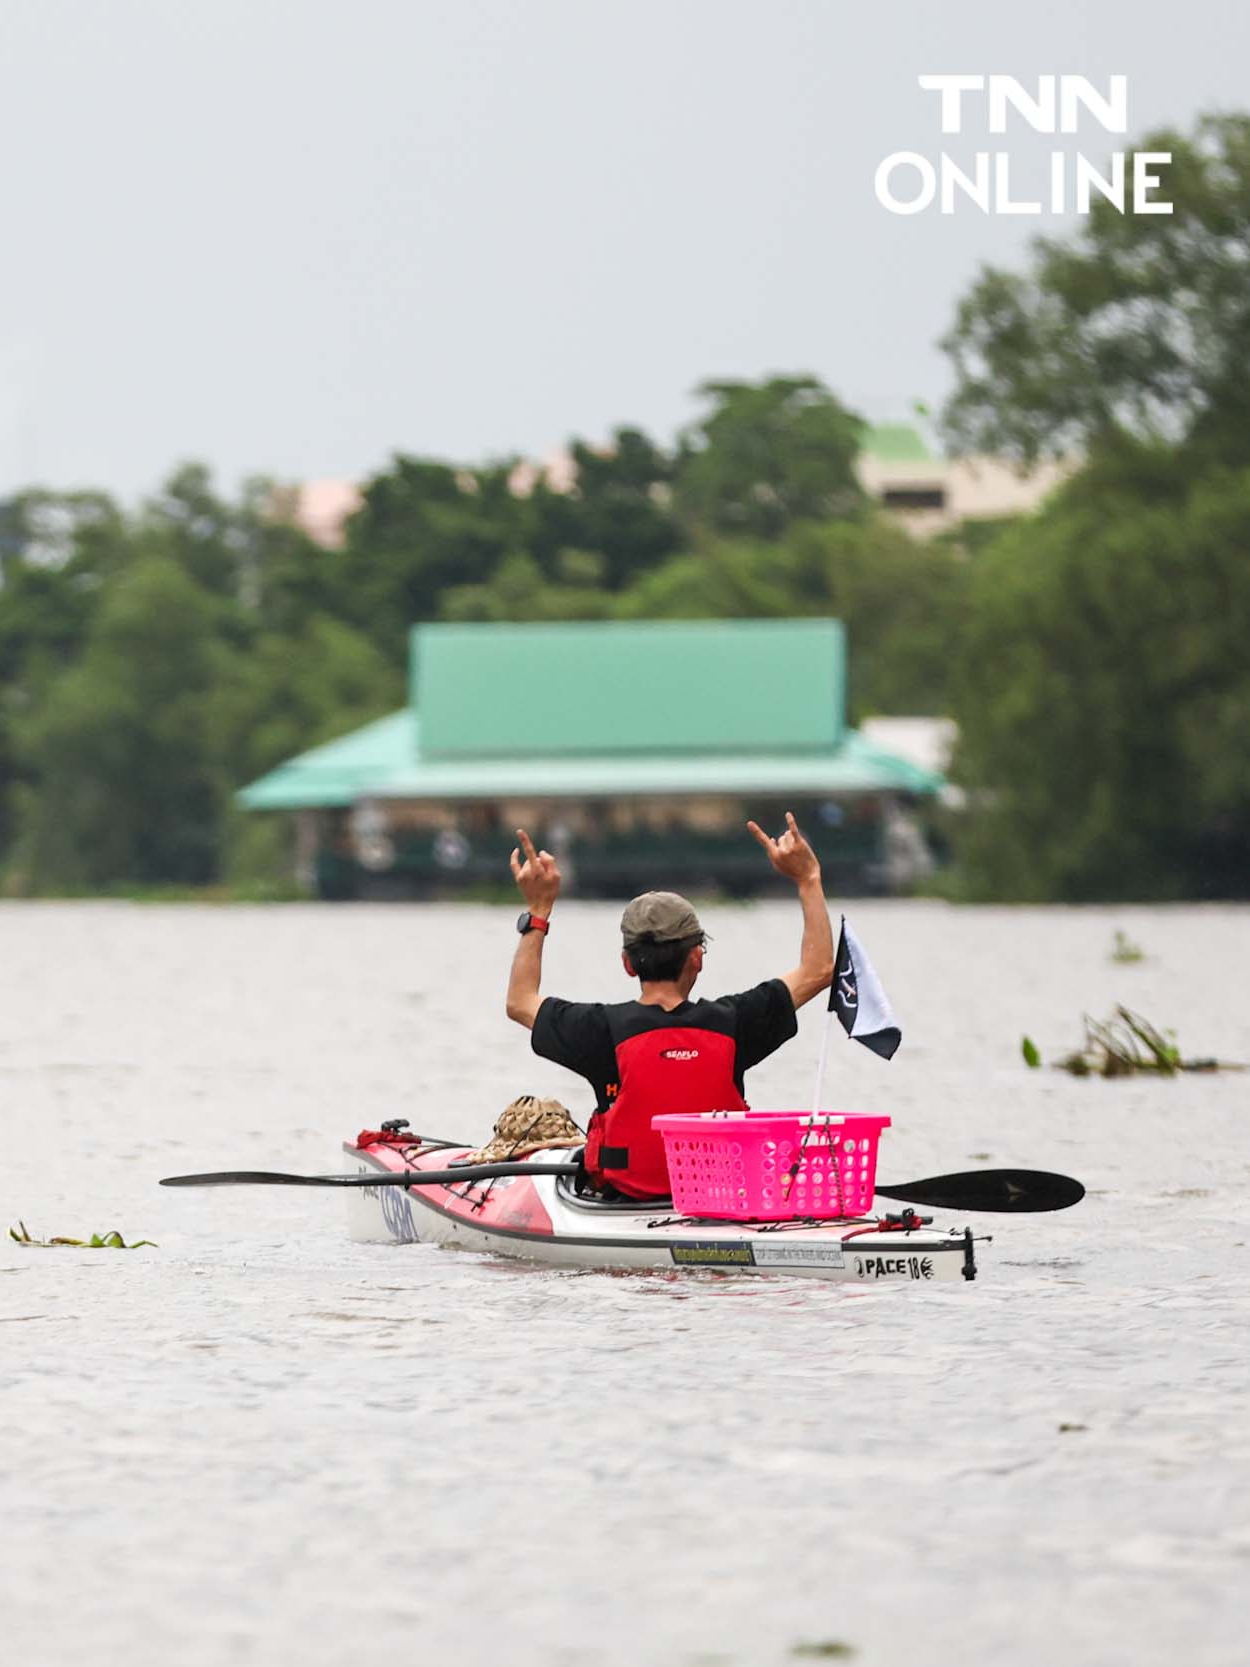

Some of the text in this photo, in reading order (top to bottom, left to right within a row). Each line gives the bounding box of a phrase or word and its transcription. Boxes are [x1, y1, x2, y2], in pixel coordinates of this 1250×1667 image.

[666, 1050, 699, 1059] SEAFLO
[865, 1257, 920, 1279] PACE 18
